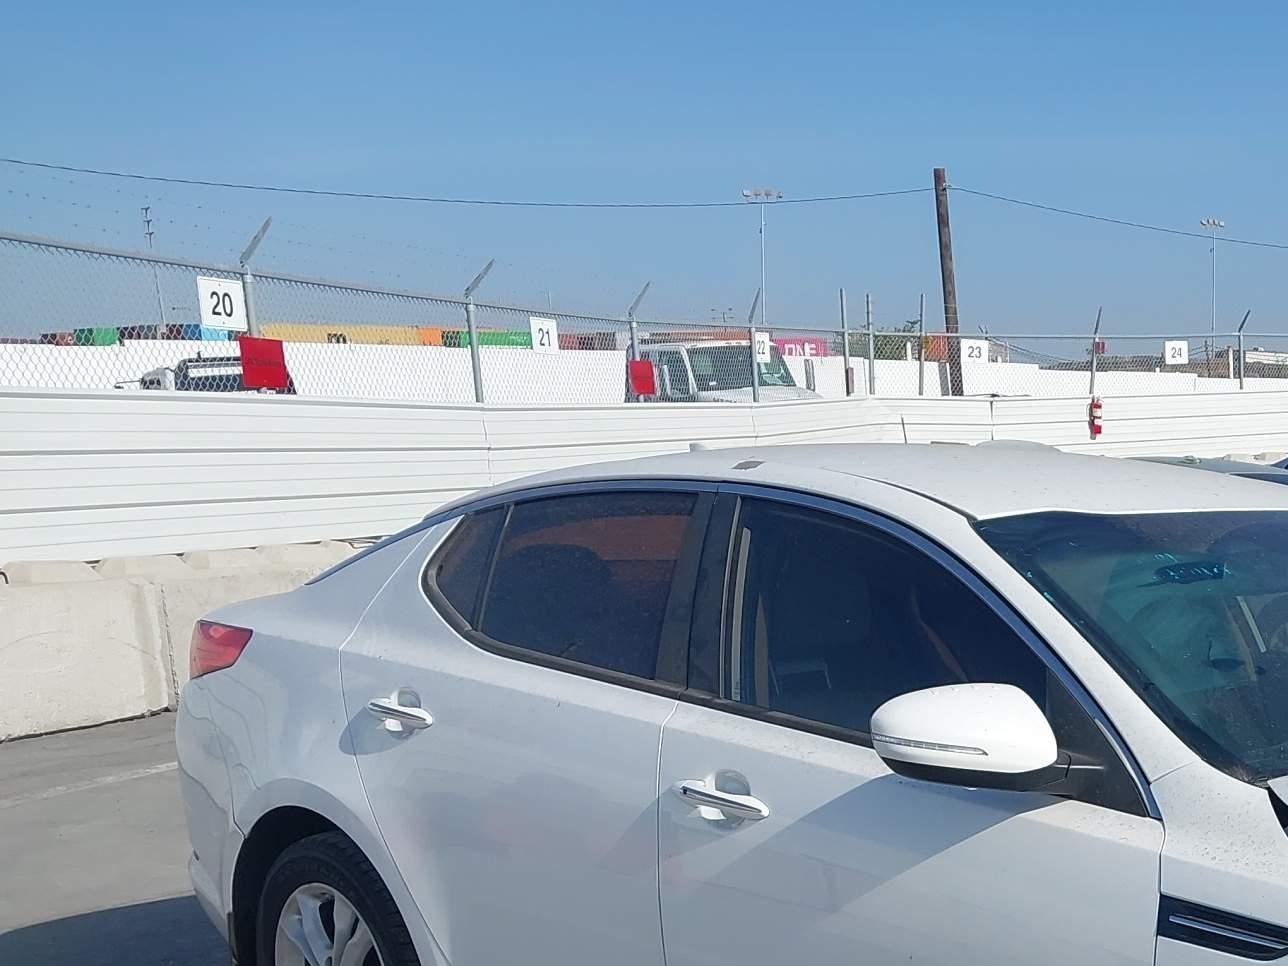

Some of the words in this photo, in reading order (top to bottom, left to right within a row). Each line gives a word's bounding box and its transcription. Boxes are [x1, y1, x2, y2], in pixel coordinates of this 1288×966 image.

[210, 291, 234, 318] 20
[538, 327, 551, 347] 21
[756, 340, 766, 355] 22
[967, 346, 982, 359] 23
[1171, 346, 1183, 359] 24
